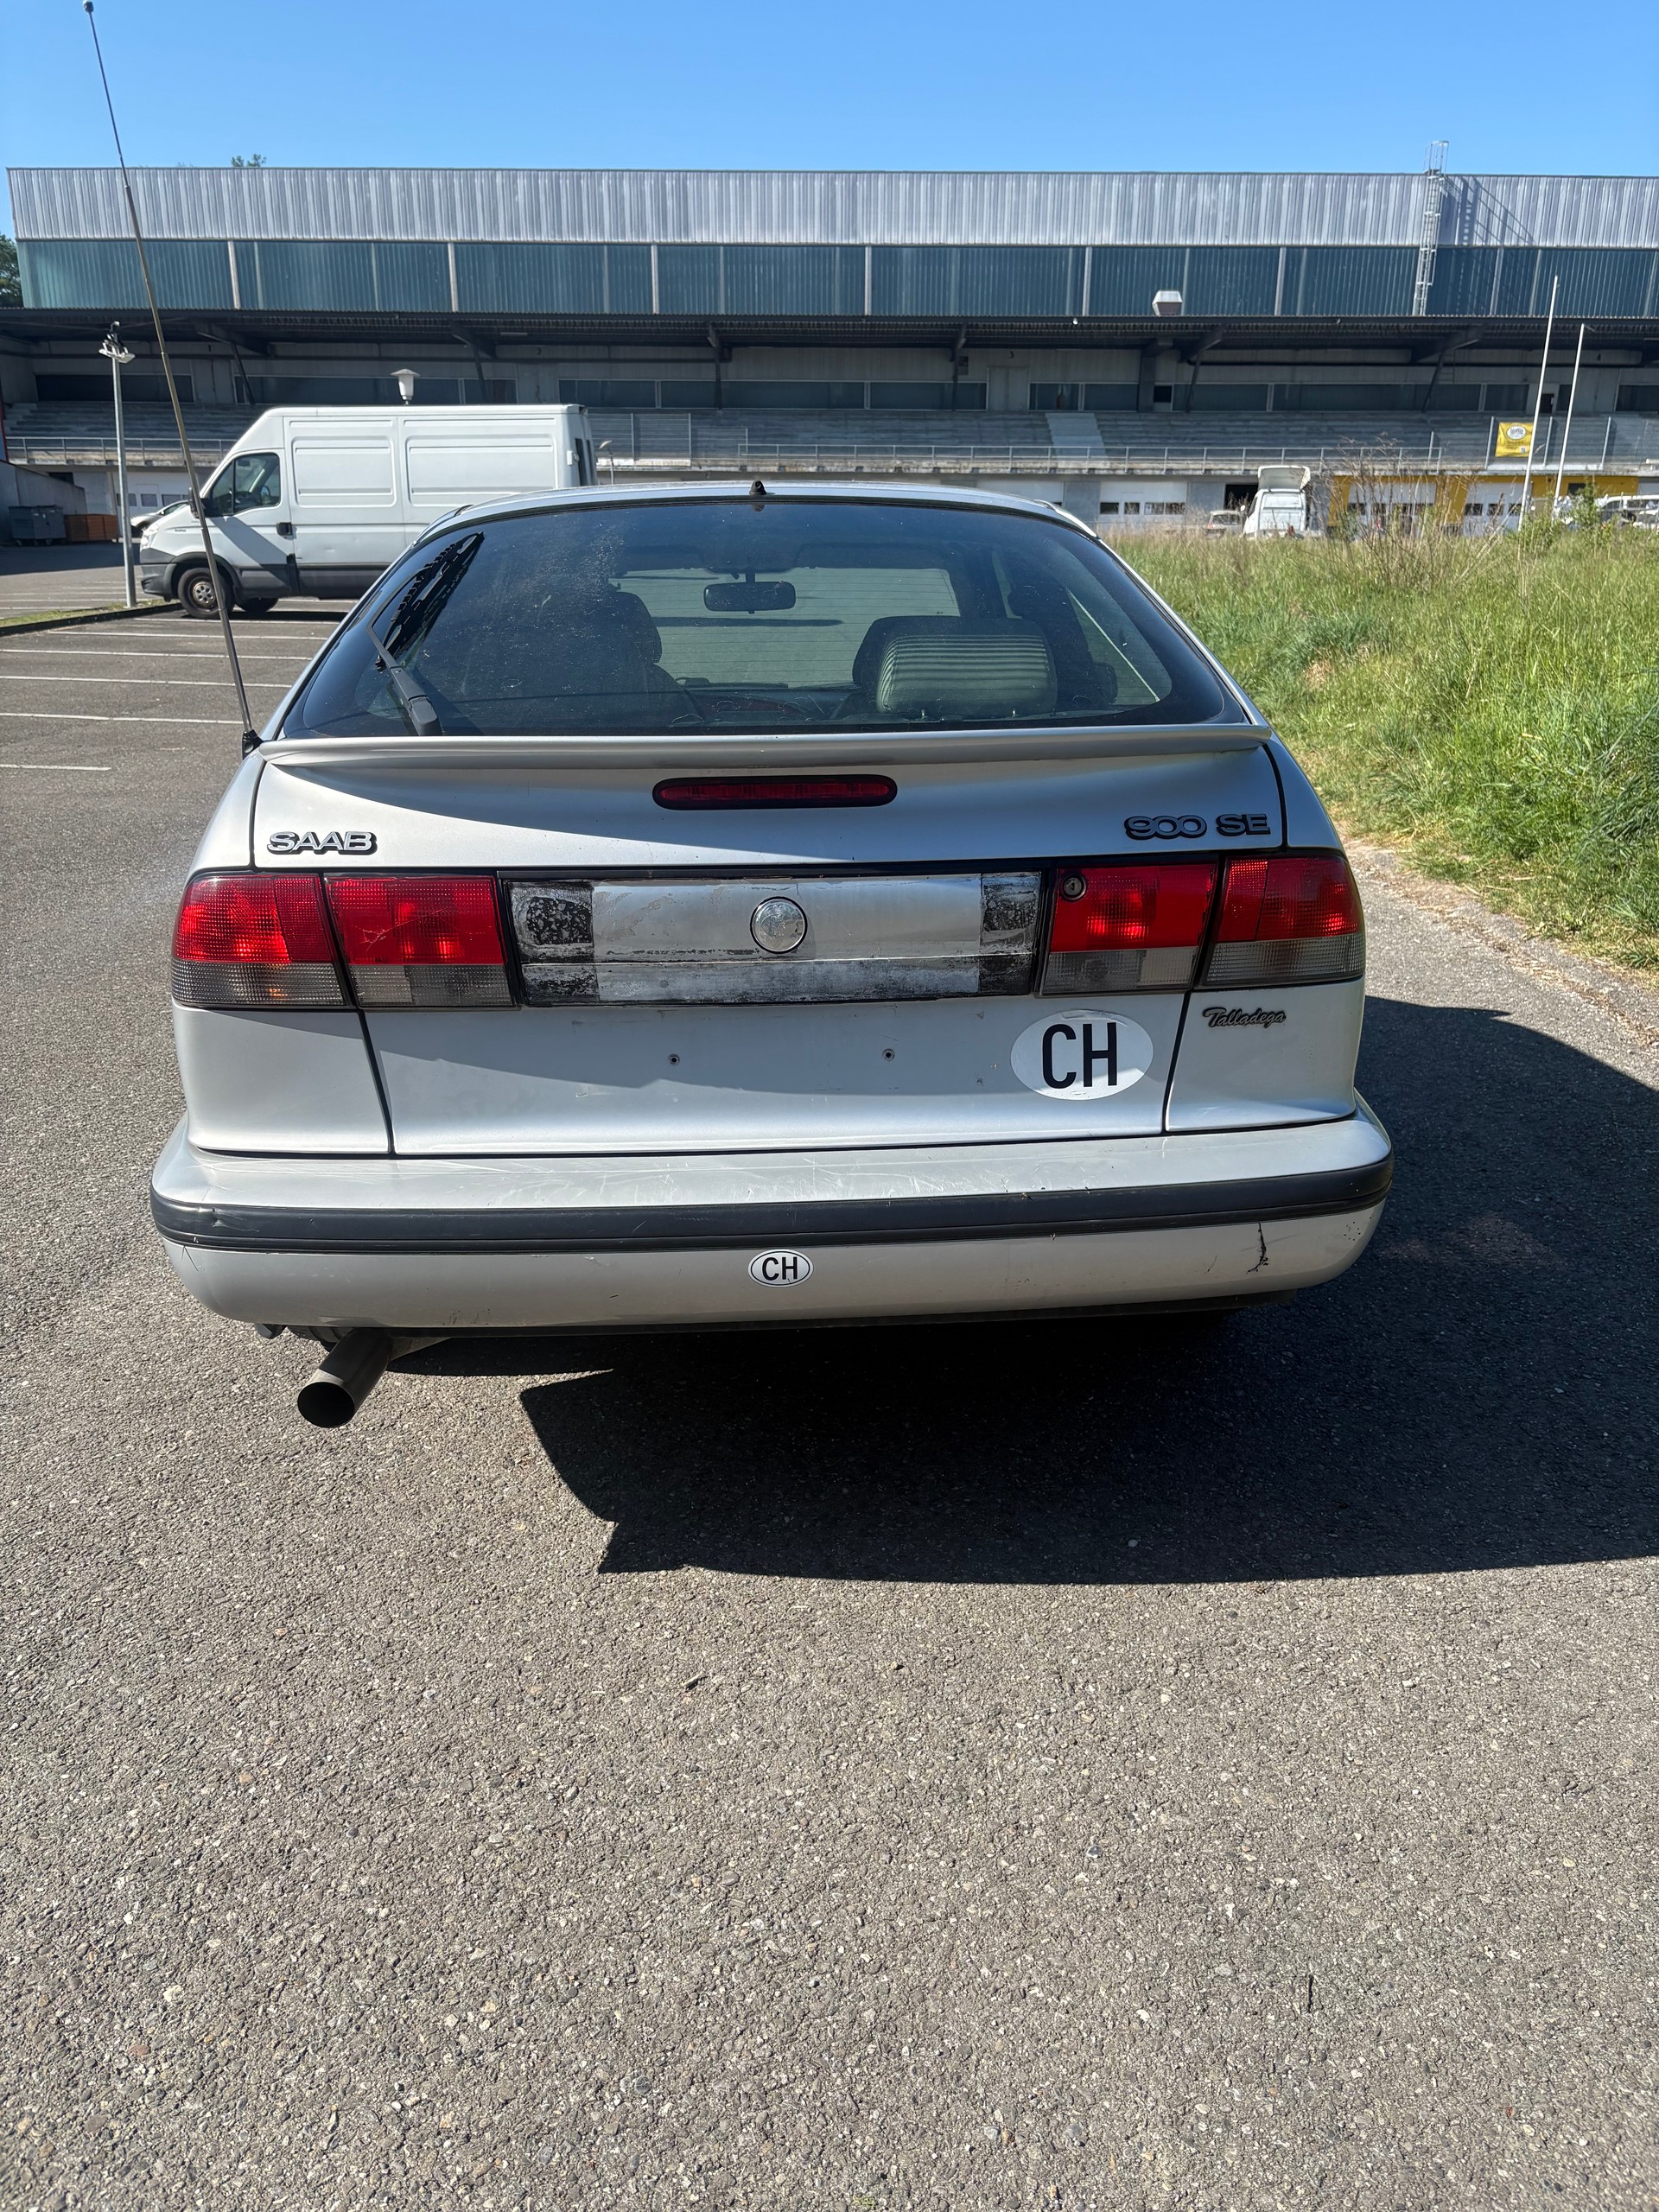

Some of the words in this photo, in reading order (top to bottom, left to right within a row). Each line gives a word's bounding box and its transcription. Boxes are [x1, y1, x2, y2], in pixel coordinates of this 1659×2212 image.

[1124, 815, 1207, 840] 900
[1216, 813, 1271, 836] SE
[267, 831, 378, 855] SAAB
[1202, 1007, 1287, 1028] Talladega
[1042, 1022, 1118, 1089] CH
[762, 1256, 798, 1281] CH
